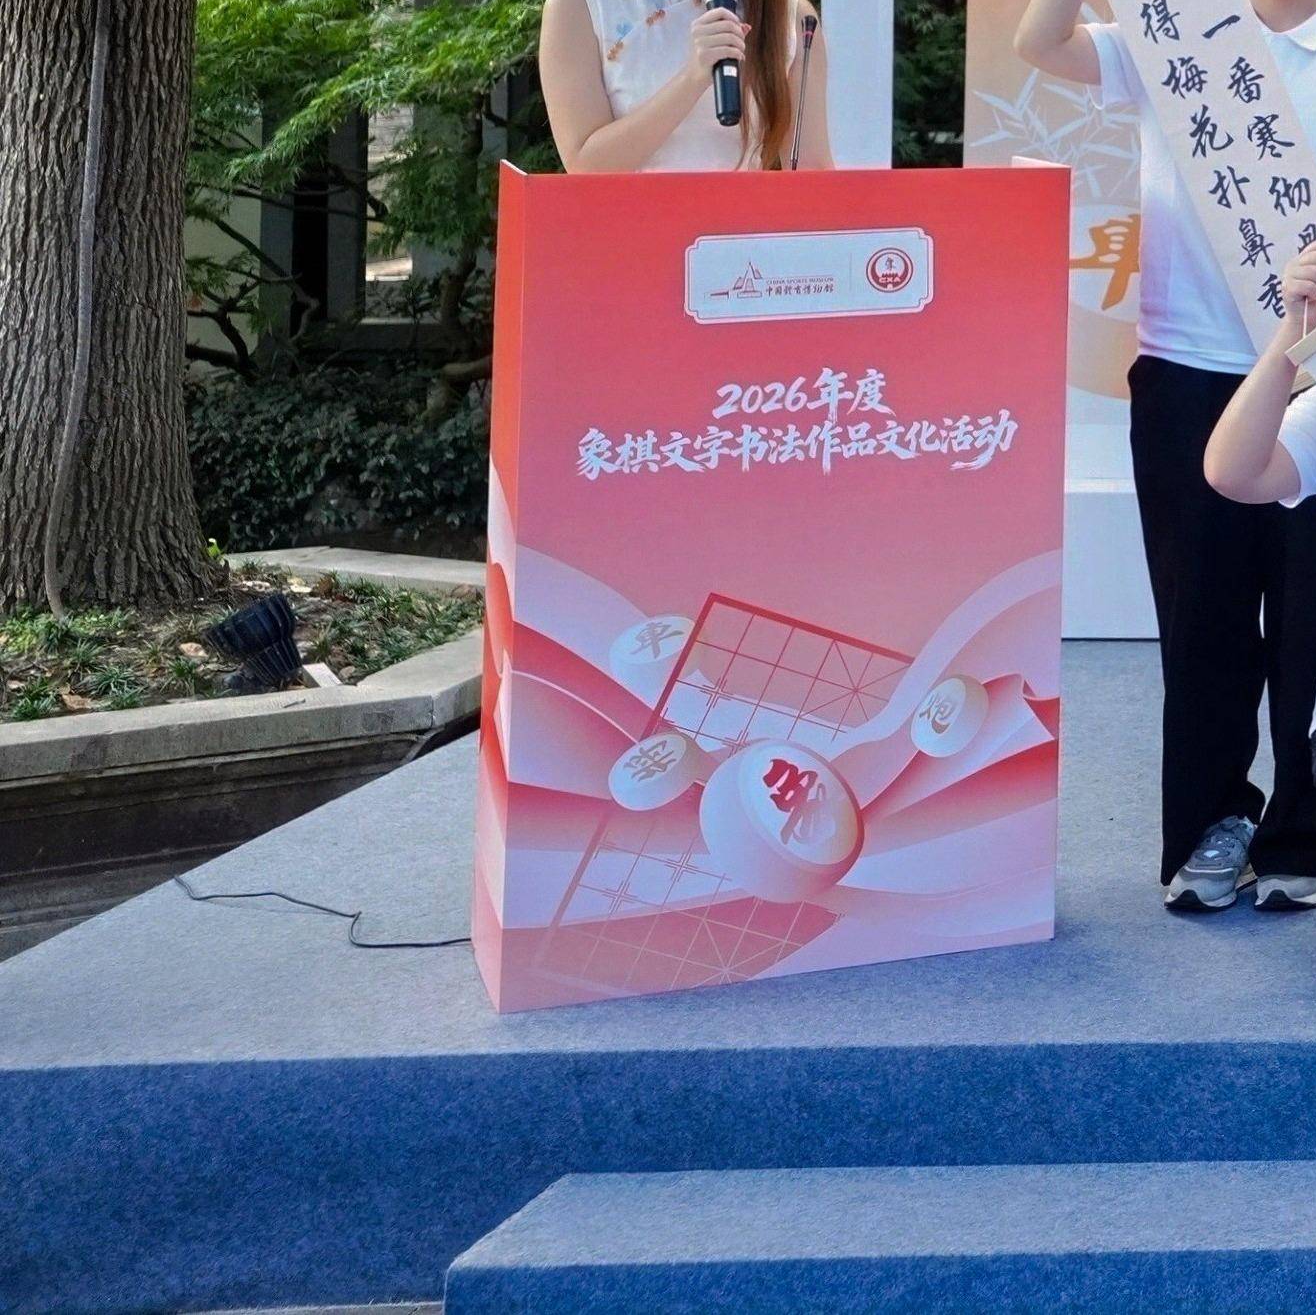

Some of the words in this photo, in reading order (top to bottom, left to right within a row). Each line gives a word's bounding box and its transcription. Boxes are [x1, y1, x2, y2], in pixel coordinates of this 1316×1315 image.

[712, 367, 896, 423] 2026年度
[576, 409, 1019, 481] 象棋文字书法作品文化活动
